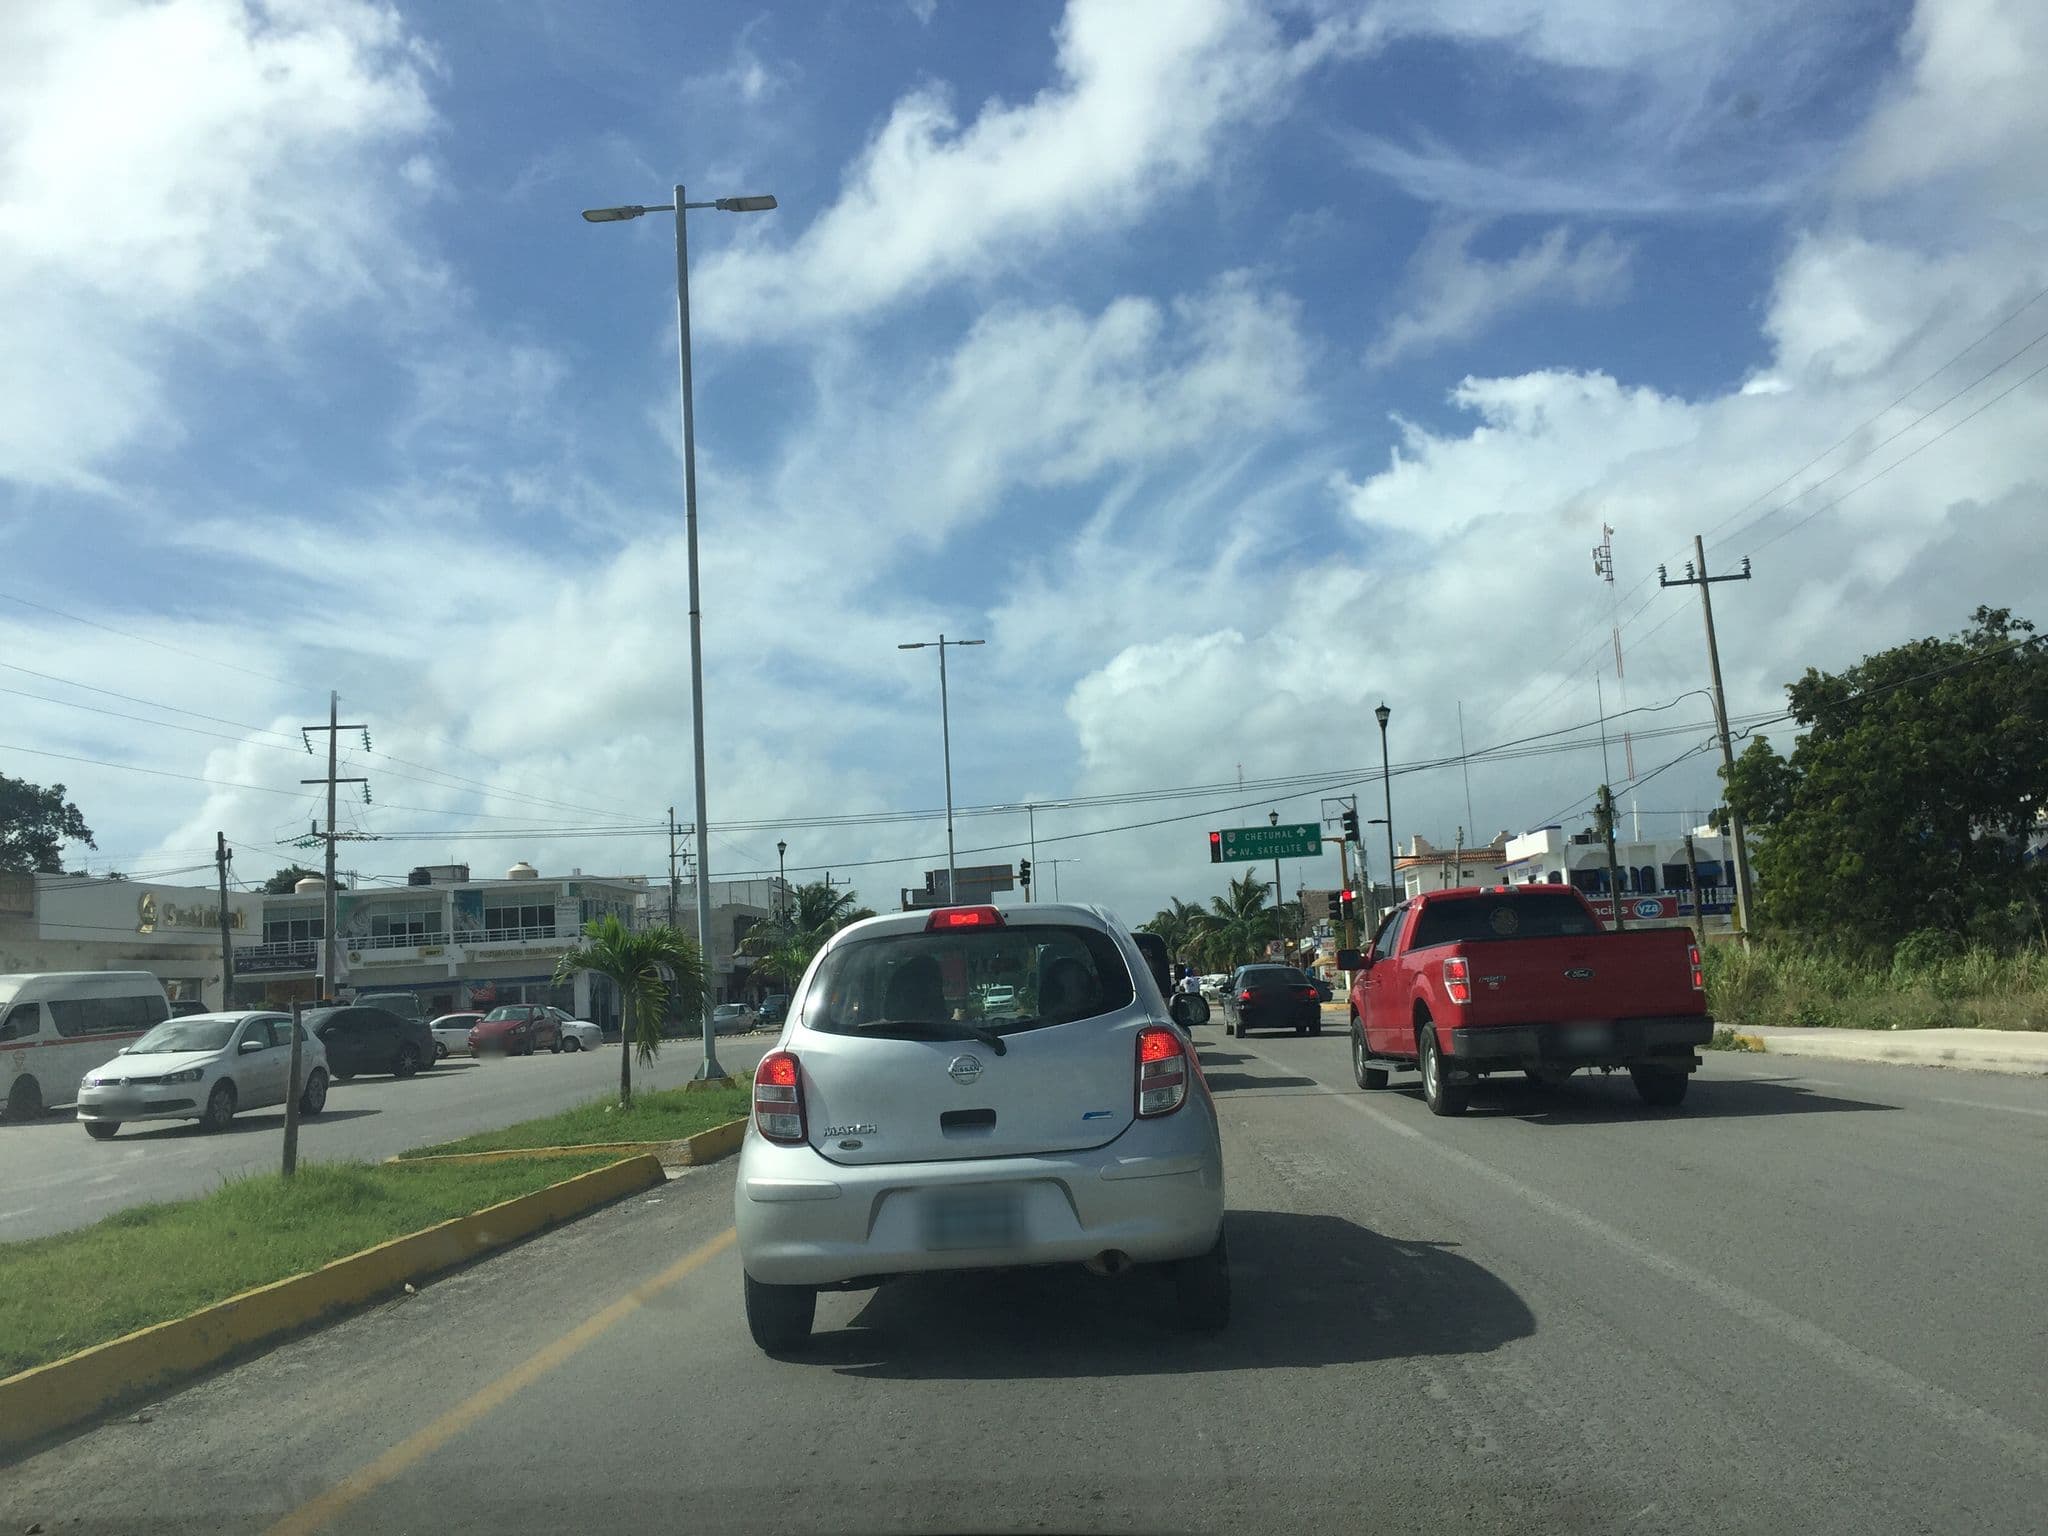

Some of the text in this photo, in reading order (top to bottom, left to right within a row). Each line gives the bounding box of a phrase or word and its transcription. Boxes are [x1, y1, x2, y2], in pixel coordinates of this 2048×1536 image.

[1244, 830, 1293, 841] CHETUMAL
[1239, 843, 1302, 857] AV. SATELITE
[1638, 903, 1658, 915] yza
[952, 1065, 980, 1073] NISSAN
[823, 1123, 878, 1137] MARCH
